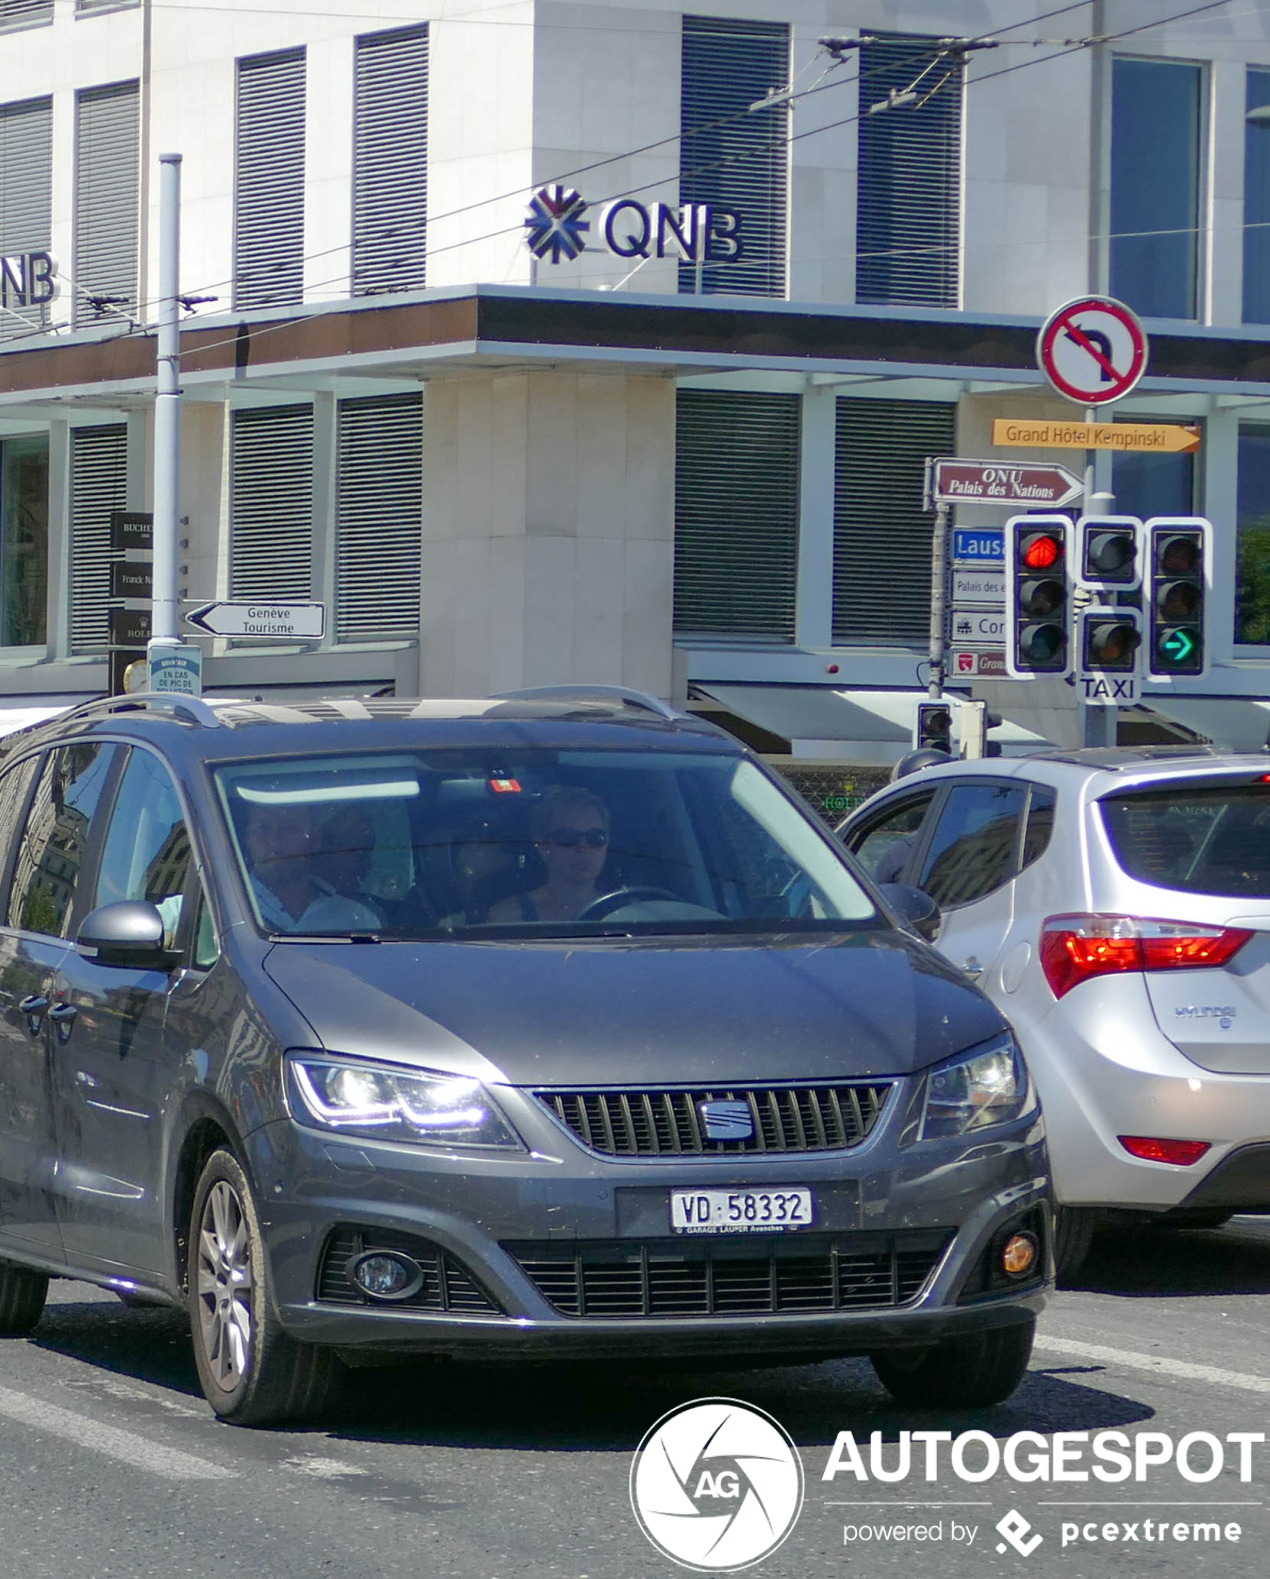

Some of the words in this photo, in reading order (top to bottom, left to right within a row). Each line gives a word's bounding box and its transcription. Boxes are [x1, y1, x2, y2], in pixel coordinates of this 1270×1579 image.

[599, 198, 743, 263] QNB
[1006, 425, 1049, 442] Grand
[1053, 426, 1090, 444] Hôtel
[1095, 429, 1165, 449] Kempinski
[982, 469, 1024, 484] ONU
[948, 479, 984, 495] Palais
[987, 482, 1007, 496] des
[1010, 483, 1055, 498] Nations
[123, 523, 154, 532] BUCHE
[957, 535, 1005, 554] Laus
[122, 574, 144, 584] Franck
[957, 580, 982, 592] Palais
[984, 581, 999, 592] des
[247, 607, 291, 619] Genève
[243, 621, 294, 634] Tourisme
[978, 618, 1006, 634] Cor
[163, 671, 173, 679] EN
[174, 671, 189, 679] CAS
[159, 679, 168, 687] DE
[183, 680, 193, 688] DE
[1080, 678, 1135, 698] TAXI
[681, 1196, 710, 1223] VD
[728, 1193, 803, 1222] 58332
[686, 1226, 717, 1234] GARAGE
[720, 1225, 749, 1233] LAUPER
[750, 1224, 784, 1233] Avenches
